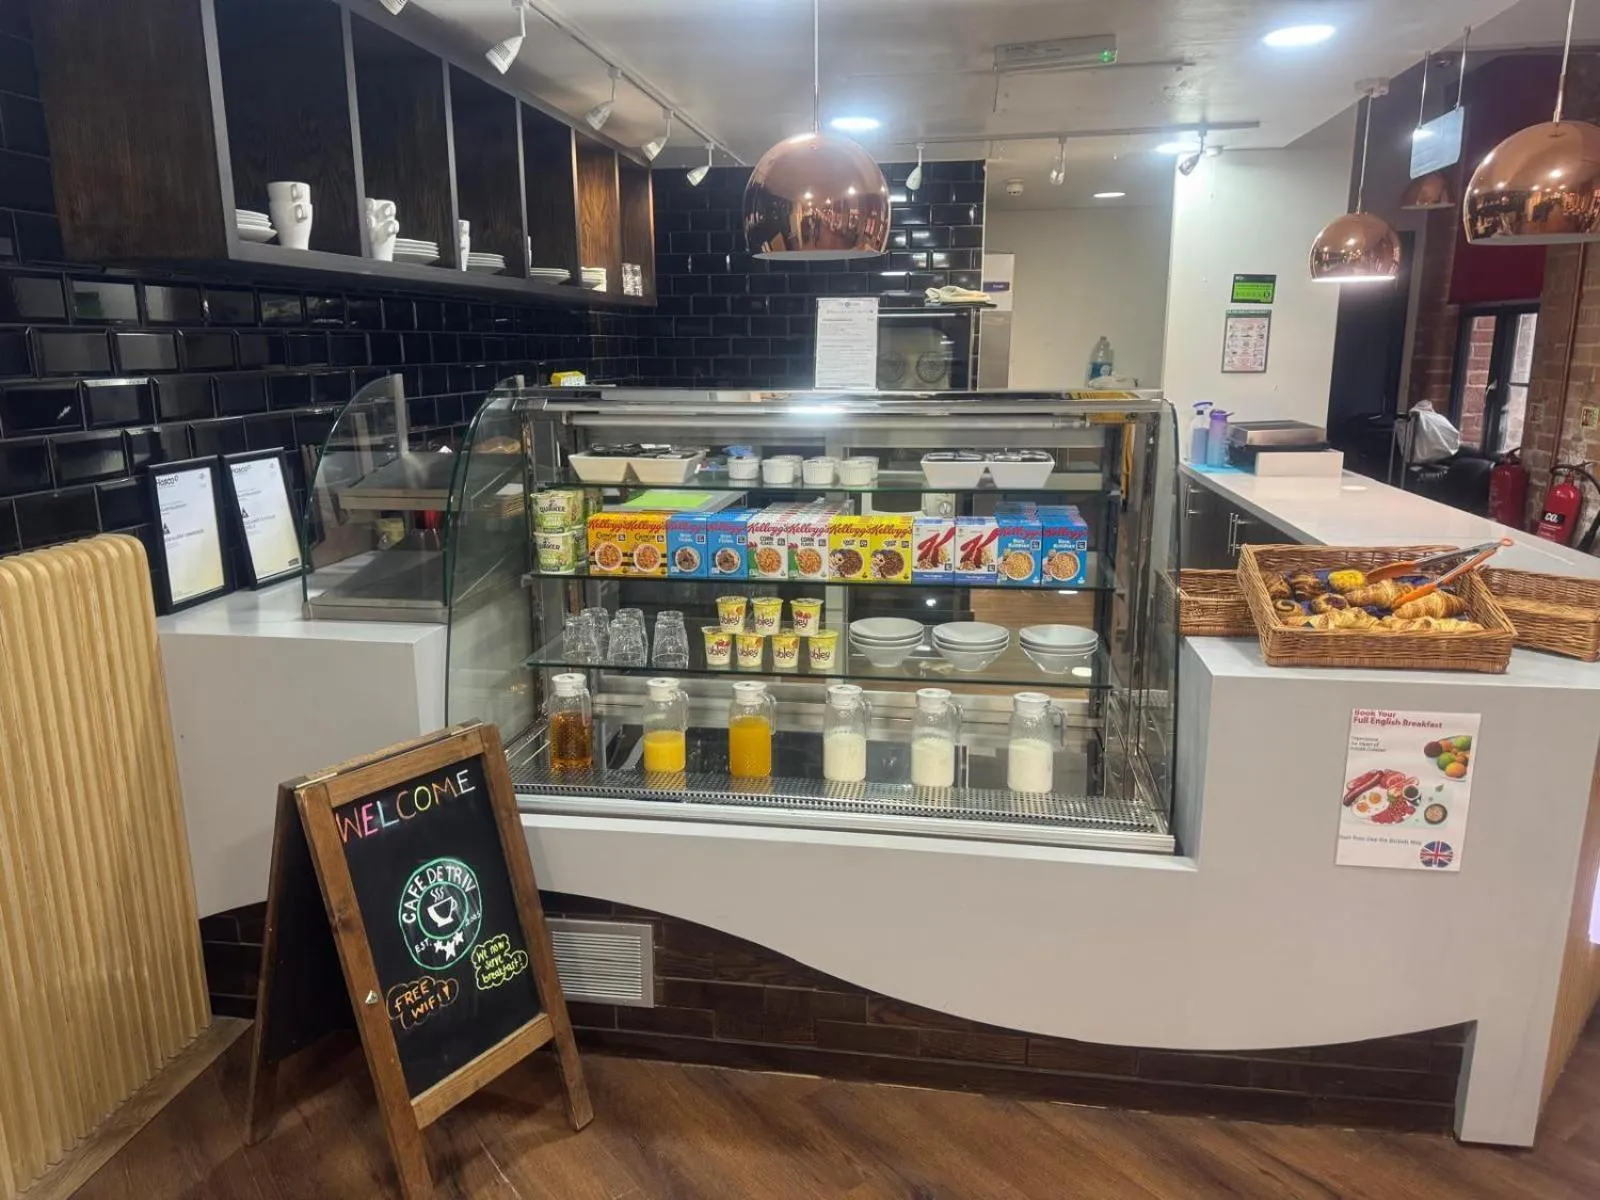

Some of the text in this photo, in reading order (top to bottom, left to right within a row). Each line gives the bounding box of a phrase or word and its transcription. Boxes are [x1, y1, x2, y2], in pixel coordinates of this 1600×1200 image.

[748, 523, 788, 536] Kellogg's
[788, 523, 829, 537] Kellogg's
[829, 524, 870, 537] Kellogg's
[870, 524, 912, 538] Kellogg's
[1370, 718, 1401, 727] English
[1402, 719, 1442, 729] Breakfast
[335, 769, 476, 843] WELCOME
[402, 875, 427, 924] CAFE
[490, 941, 505, 954] now
[395, 980, 430, 1012] FREE
